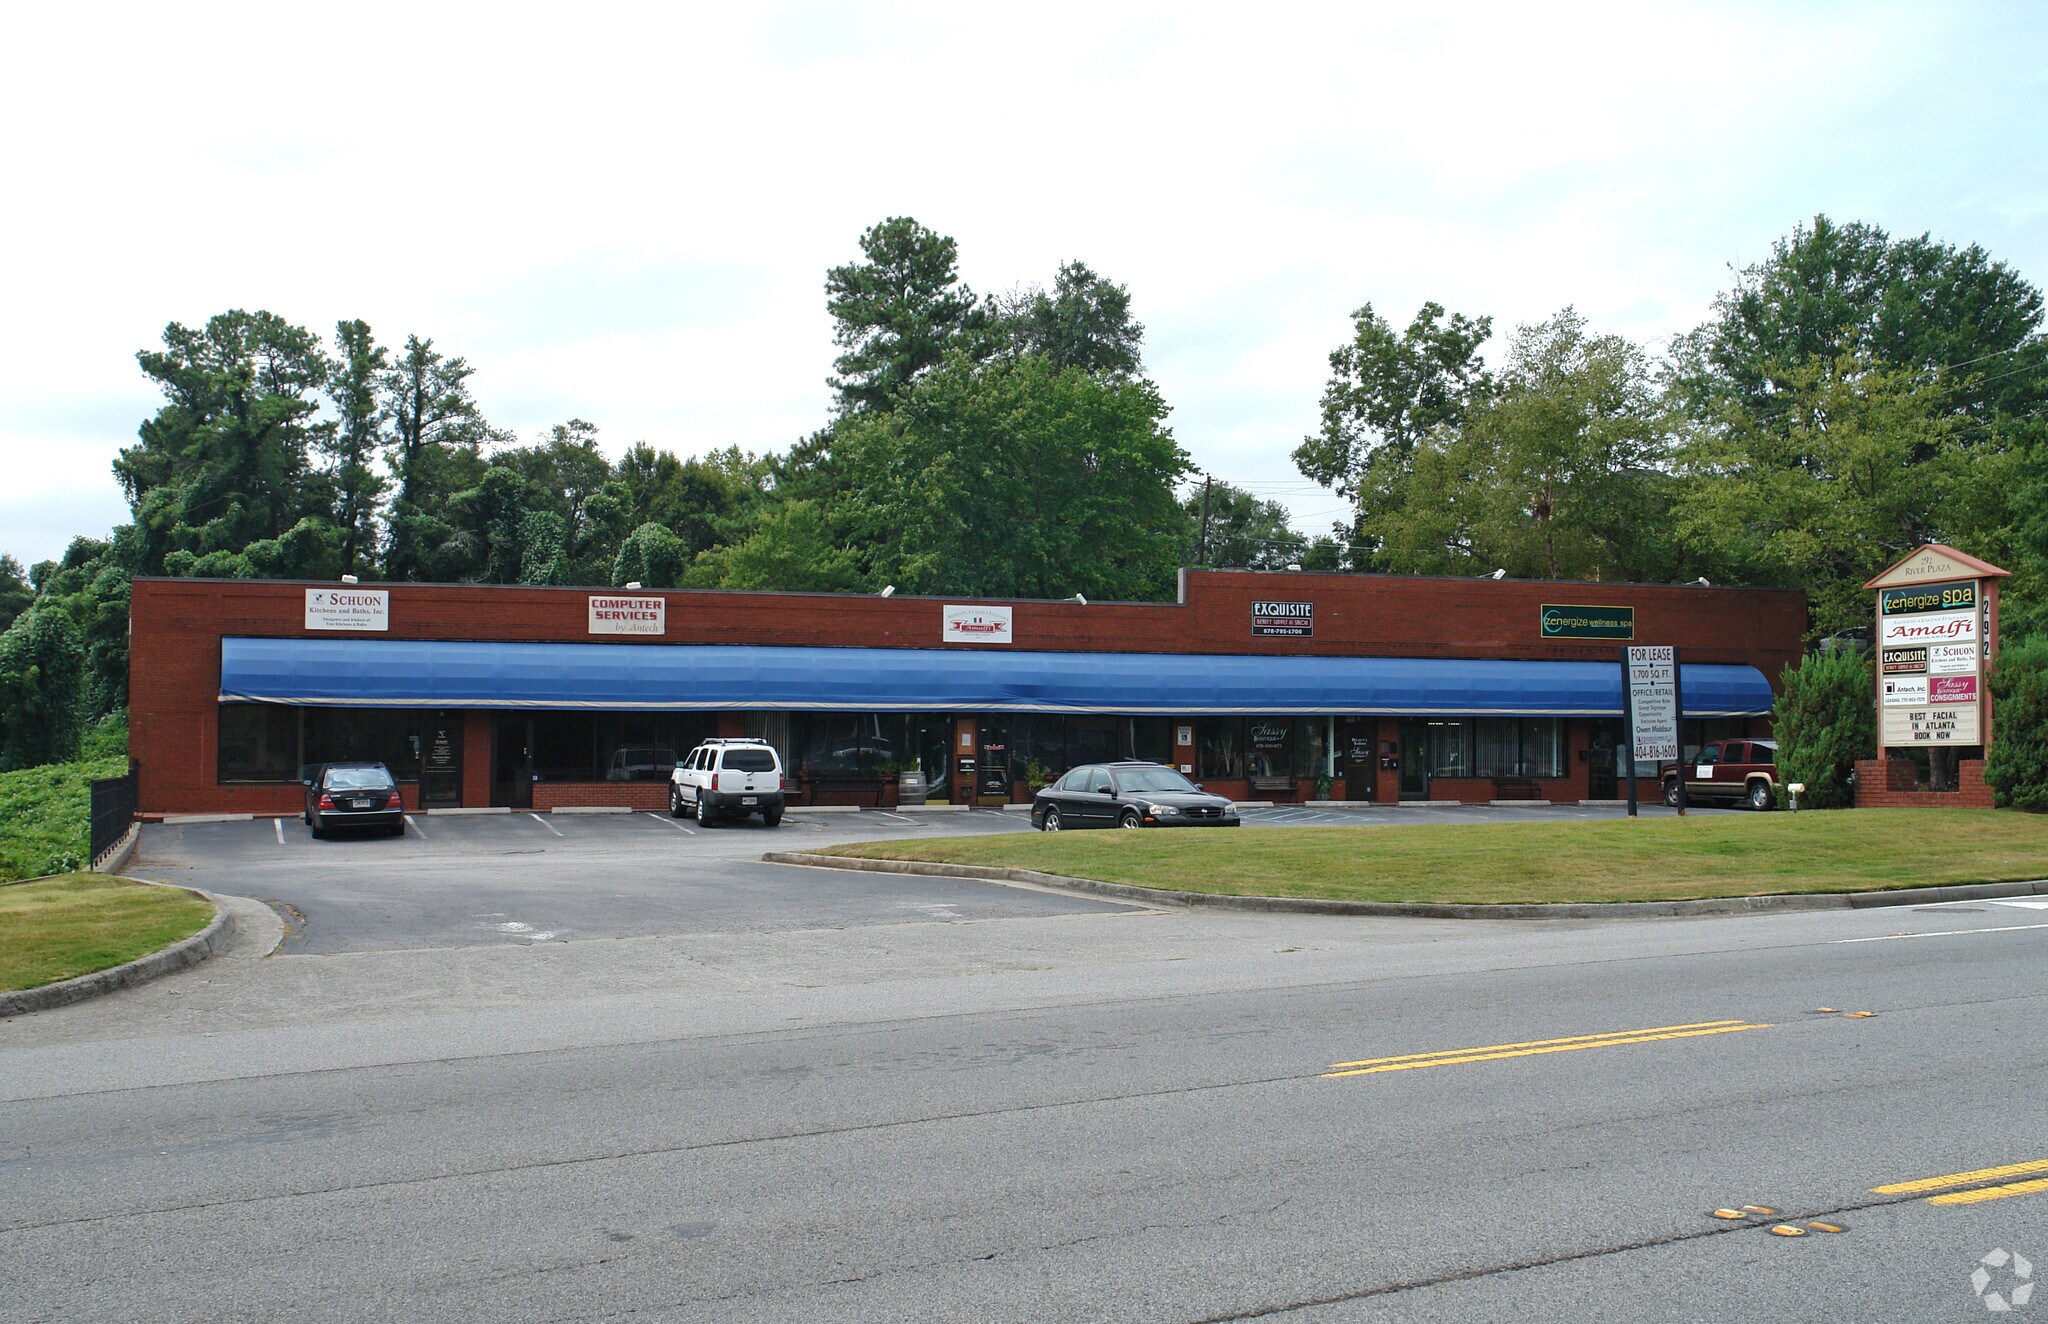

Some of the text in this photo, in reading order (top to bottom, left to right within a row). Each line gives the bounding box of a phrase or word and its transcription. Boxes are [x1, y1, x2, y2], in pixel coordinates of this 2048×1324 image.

[1921, 556, 1932, 565] 292
[1905, 564, 1951, 575] RIVER PLAZA
[330, 593, 381, 606] SCHUON
[592, 599, 662, 609] COMPUTER
[1886, 588, 1973, 609] zenergize spa
[595, 610, 657, 620] SERVICES
[1254, 603, 1311, 616] EXQUISITE
[615, 622, 658, 633] by Antech
[1545, 617, 1589, 628] zenergize
[1620, 620, 1632, 628] spa
[1887, 619, 1973, 638] Amalfi
[1631, 648, 1671, 661] FOR LEASE
[1884, 650, 1926, 662] EXQUISITE
[1943, 646, 1975, 657] SCHUON
[1633, 669, 1671, 679] 1,700 SQ. FT.
[1937, 677, 1969, 691] Sassy
[1632, 689, 1673, 697] OFFICE/RETAIL
[1930, 693, 1976, 702] CONSIGNMENTS
[1909, 711, 1957, 720] BEST FACIAL
[1251, 721, 1288, 739] Sassy
[1636, 725, 1651, 733] Owen
[1911, 721, 1956, 730] IN ATLANTA
[1914, 731, 1951, 740] BOOK NOW
[1635, 745, 1677, 758] 404-816-1600
